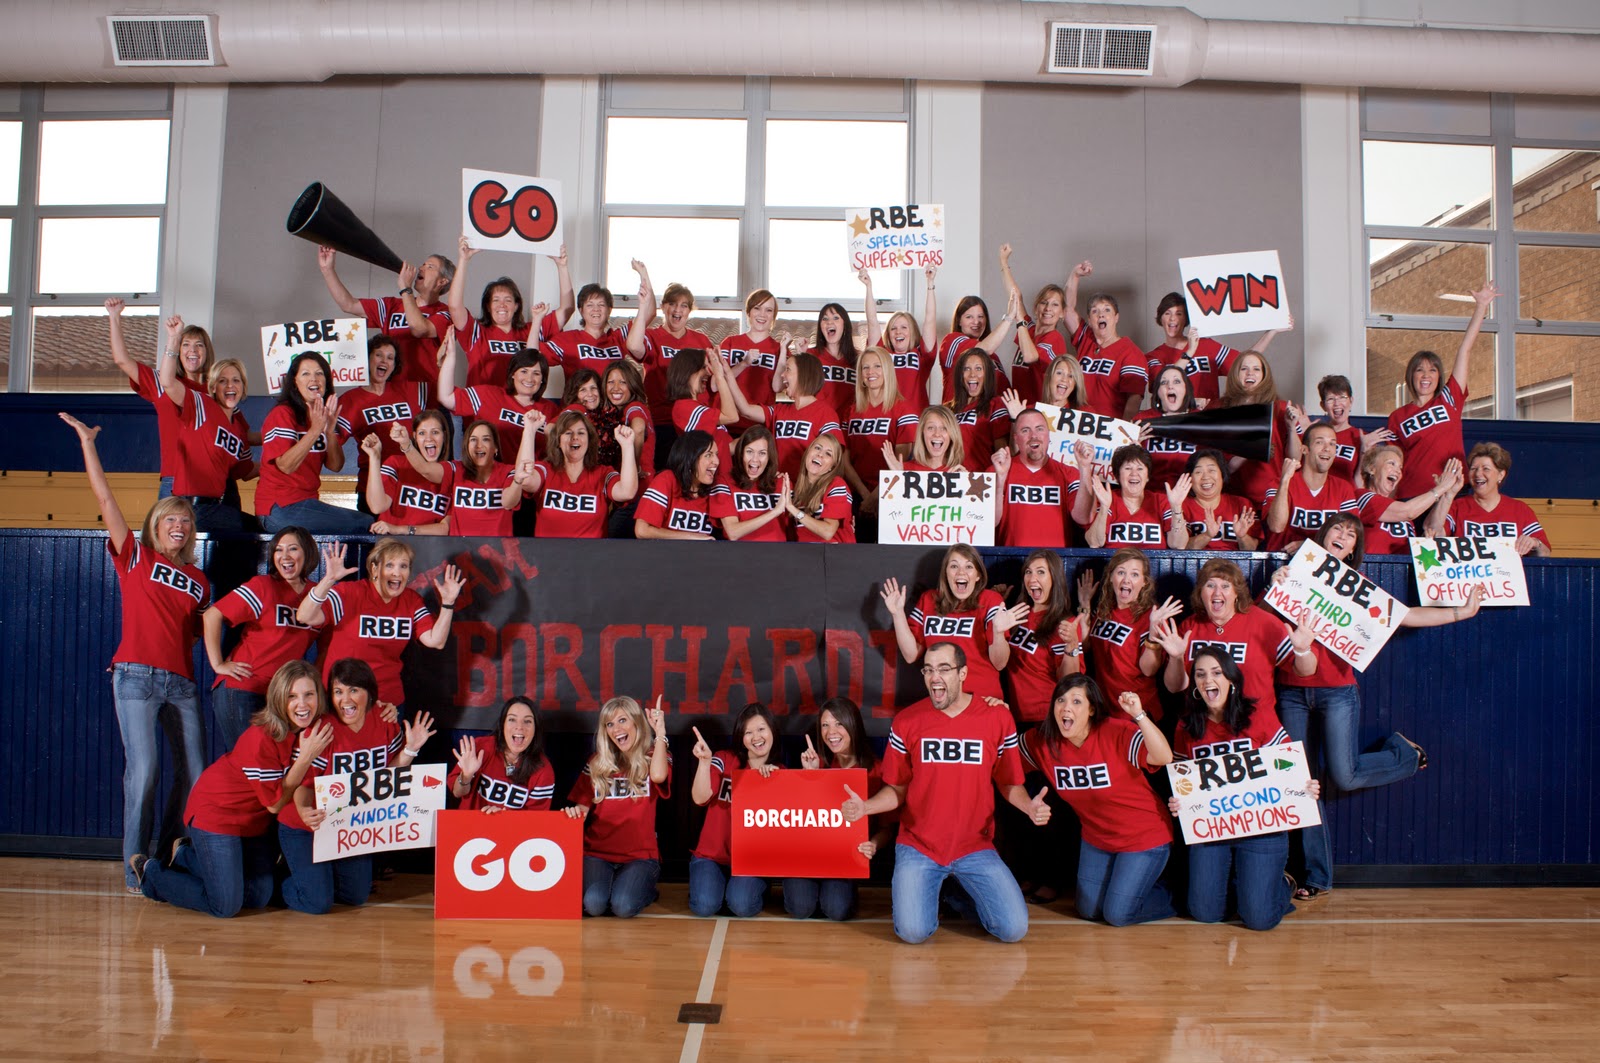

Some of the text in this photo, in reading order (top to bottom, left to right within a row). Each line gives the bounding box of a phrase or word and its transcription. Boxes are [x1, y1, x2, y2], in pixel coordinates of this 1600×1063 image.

[468, 180, 558, 242] GO
[870, 205, 924, 230] RBE
[867, 233, 929, 249] SPECIALS
[1186, 272, 1279, 316] WIN
[284, 319, 339, 347] RBE
[579, 345, 622, 359] RBE
[731, 350, 775, 368] RE
[893, 353, 919, 370] BE
[331, 367, 366, 382] AGUE
[1080, 357, 1115, 375] RBE
[1187, 357, 1210, 374] BE
[365, 403, 411, 424] RBE
[1057, 407, 1115, 441] RBE
[1402, 406, 1449, 435] RBE
[776, 421, 810, 438] RBE
[850, 419, 890, 435] RBE
[902, 471, 963, 499] RBE
[1010, 485, 1060, 504] RBE
[400, 487, 449, 514] RBE
[456, 489, 503, 508] RBE
[545, 490, 595, 512] RBE
[911, 504, 962, 523] FIFTH
[897, 523, 976, 544] VARSITY
[1110, 524, 1160, 542] RBE
[1467, 522, 1516, 537] RBE
[1433, 537, 1496, 563] RBE
[152, 563, 203, 601] RBE
[1312, 553, 1376, 609] RBE
[1446, 564, 1493, 579] OFFICE
[1427, 581, 1516, 601] OFFICALS
[1306, 587, 1352, 627] THIRD
[361, 617, 411, 639] RBE
[925, 617, 973, 636] RBE
[1091, 619, 1131, 645] RBE
[1010, 627, 1037, 652] BE
[334, 747, 386, 775] RBE
[923, 740, 981, 763] RBE
[1056, 765, 1110, 788] RBE
[1194, 749, 1268, 791] RBE
[348, 765, 412, 807] RBE
[477, 775, 527, 807] RBE
[1209, 787, 1281, 816] SECOND
[350, 802, 409, 827] KINDER
[743, 808, 851, 828] BORCHARD
[1192, 805, 1300, 839] CHAMPIONS
[337, 822, 420, 853] ROOKIES
[453, 837, 566, 892] GO
